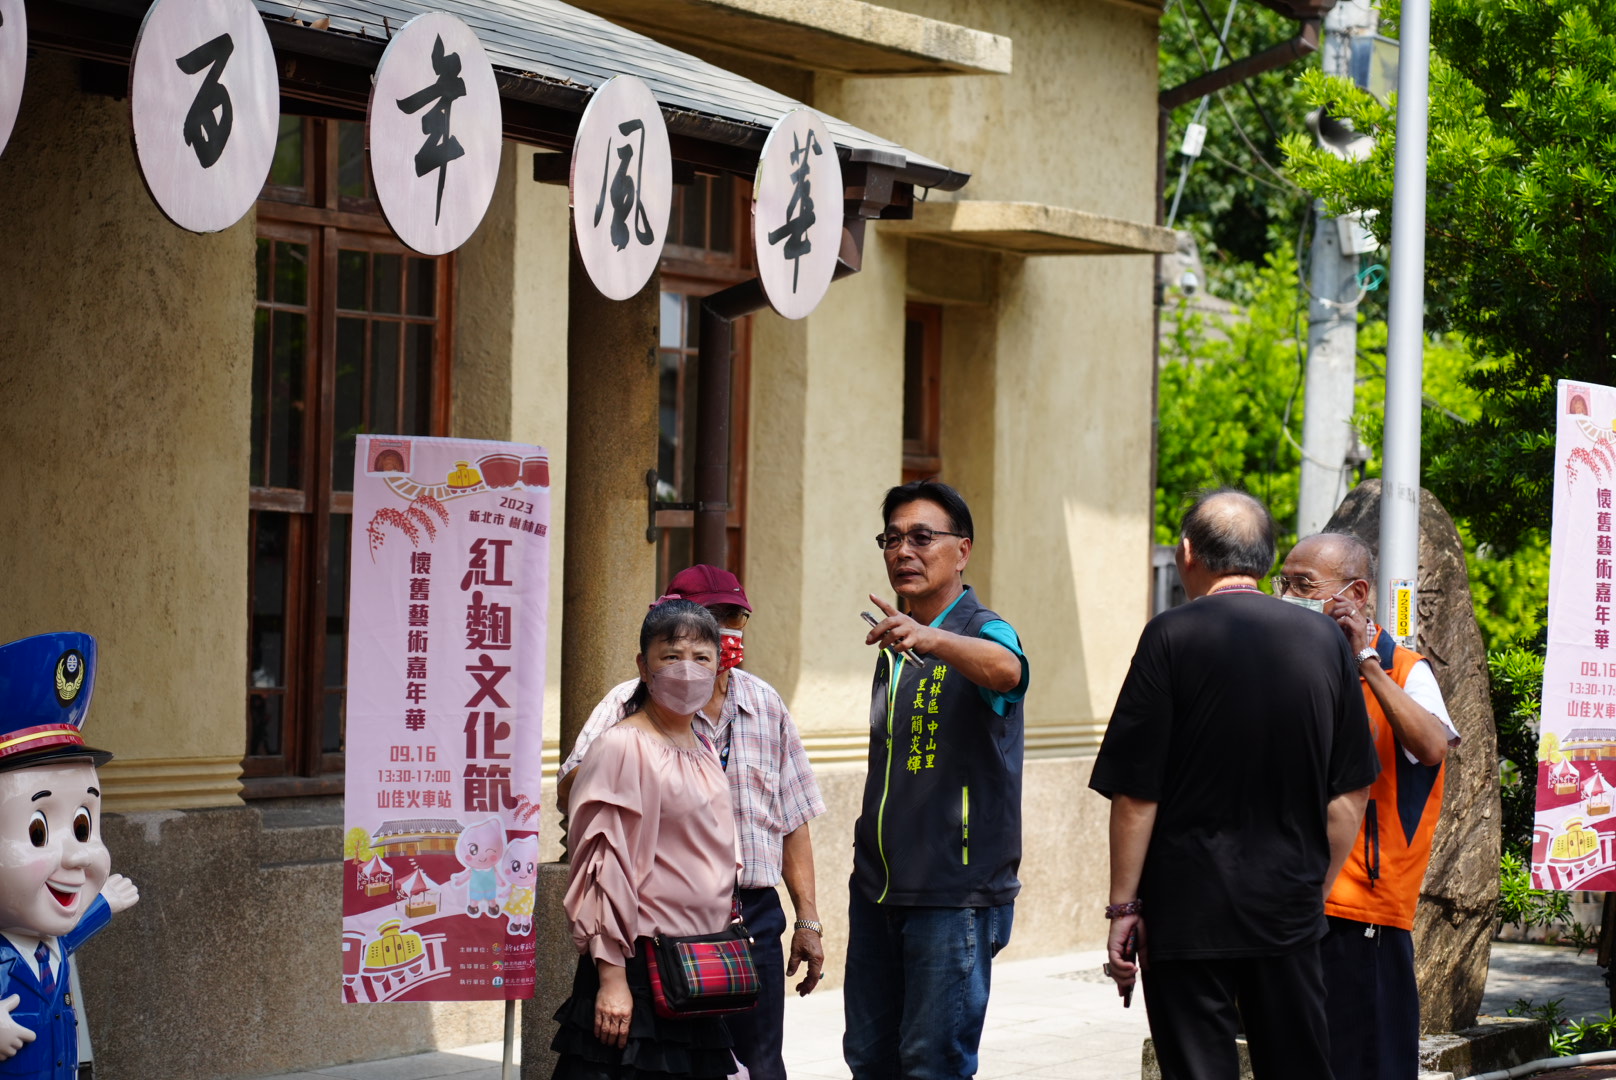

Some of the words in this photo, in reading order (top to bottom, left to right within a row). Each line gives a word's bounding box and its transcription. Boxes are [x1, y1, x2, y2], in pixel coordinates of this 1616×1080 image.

[176, 32, 234, 168] 百
[396, 32, 466, 227] 年
[595, 119, 655, 253] 風
[768, 129, 823, 294] 華
[469, 509, 505, 526] 新北市
[508, 516, 548, 537] 樹林區
[499, 496, 534, 515] 2023
[1594, 487, 1612, 649] 懷舊藝術嘉年華
[1400, 591, 1409, 635] 723303
[405, 551, 432, 731] 懷舊藝術嘉年華
[460, 538, 519, 812] 紅麴文化節
[1581, 661, 1616, 677] 09.16
[912, 678, 928, 709] 里長
[927, 665, 948, 714] 樹林區
[1567, 700, 1616, 719] 山佳火車
[389, 746, 437, 763] 09.16
[906, 715, 924, 775] 簡炎輝
[925, 720, 939, 769] 中山里
[377, 769, 452, 784] 13:30-17:00
[377, 789, 452, 809] 山佳火車站
